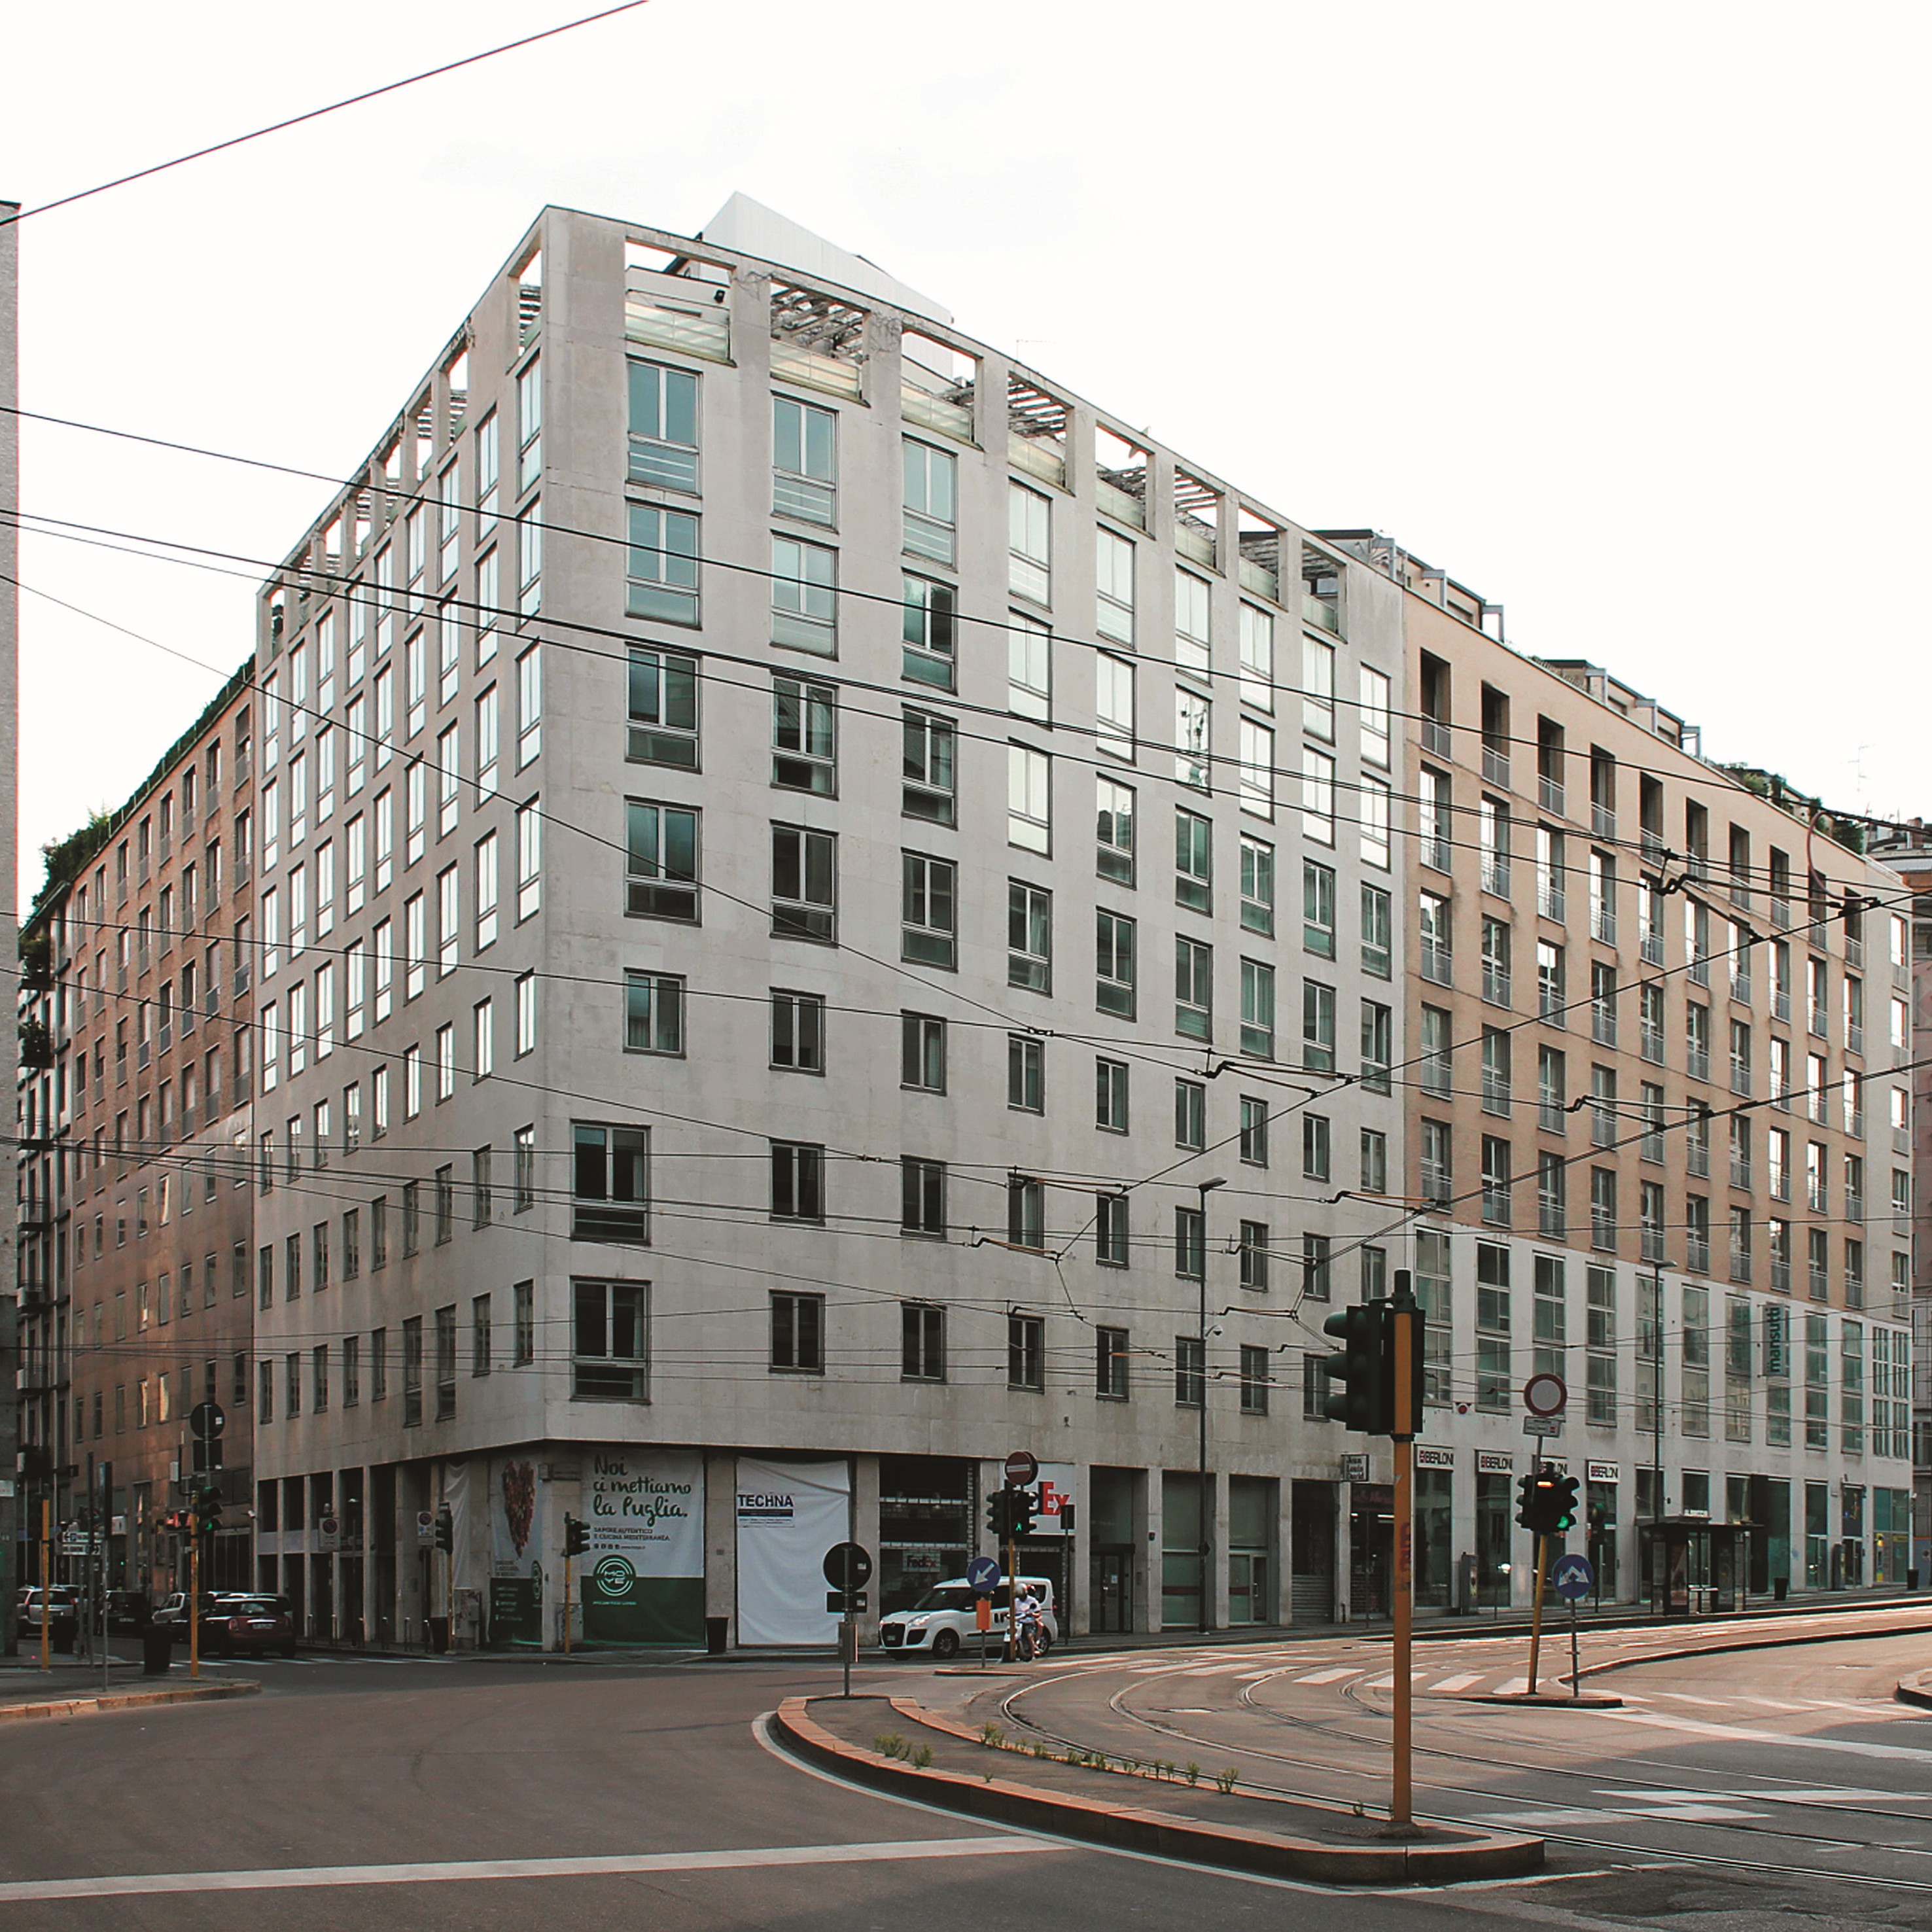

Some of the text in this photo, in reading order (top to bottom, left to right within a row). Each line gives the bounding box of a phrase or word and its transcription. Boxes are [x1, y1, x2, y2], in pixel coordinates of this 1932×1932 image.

[1766, 1307, 1780, 1372] mansutti
[594, 1454, 628, 1475] Noi
[593, 1476, 691, 1494] ci mettiamo
[593, 1494, 688, 1527] la Puglia.
[737, 1494, 794, 1507] TECHNA
